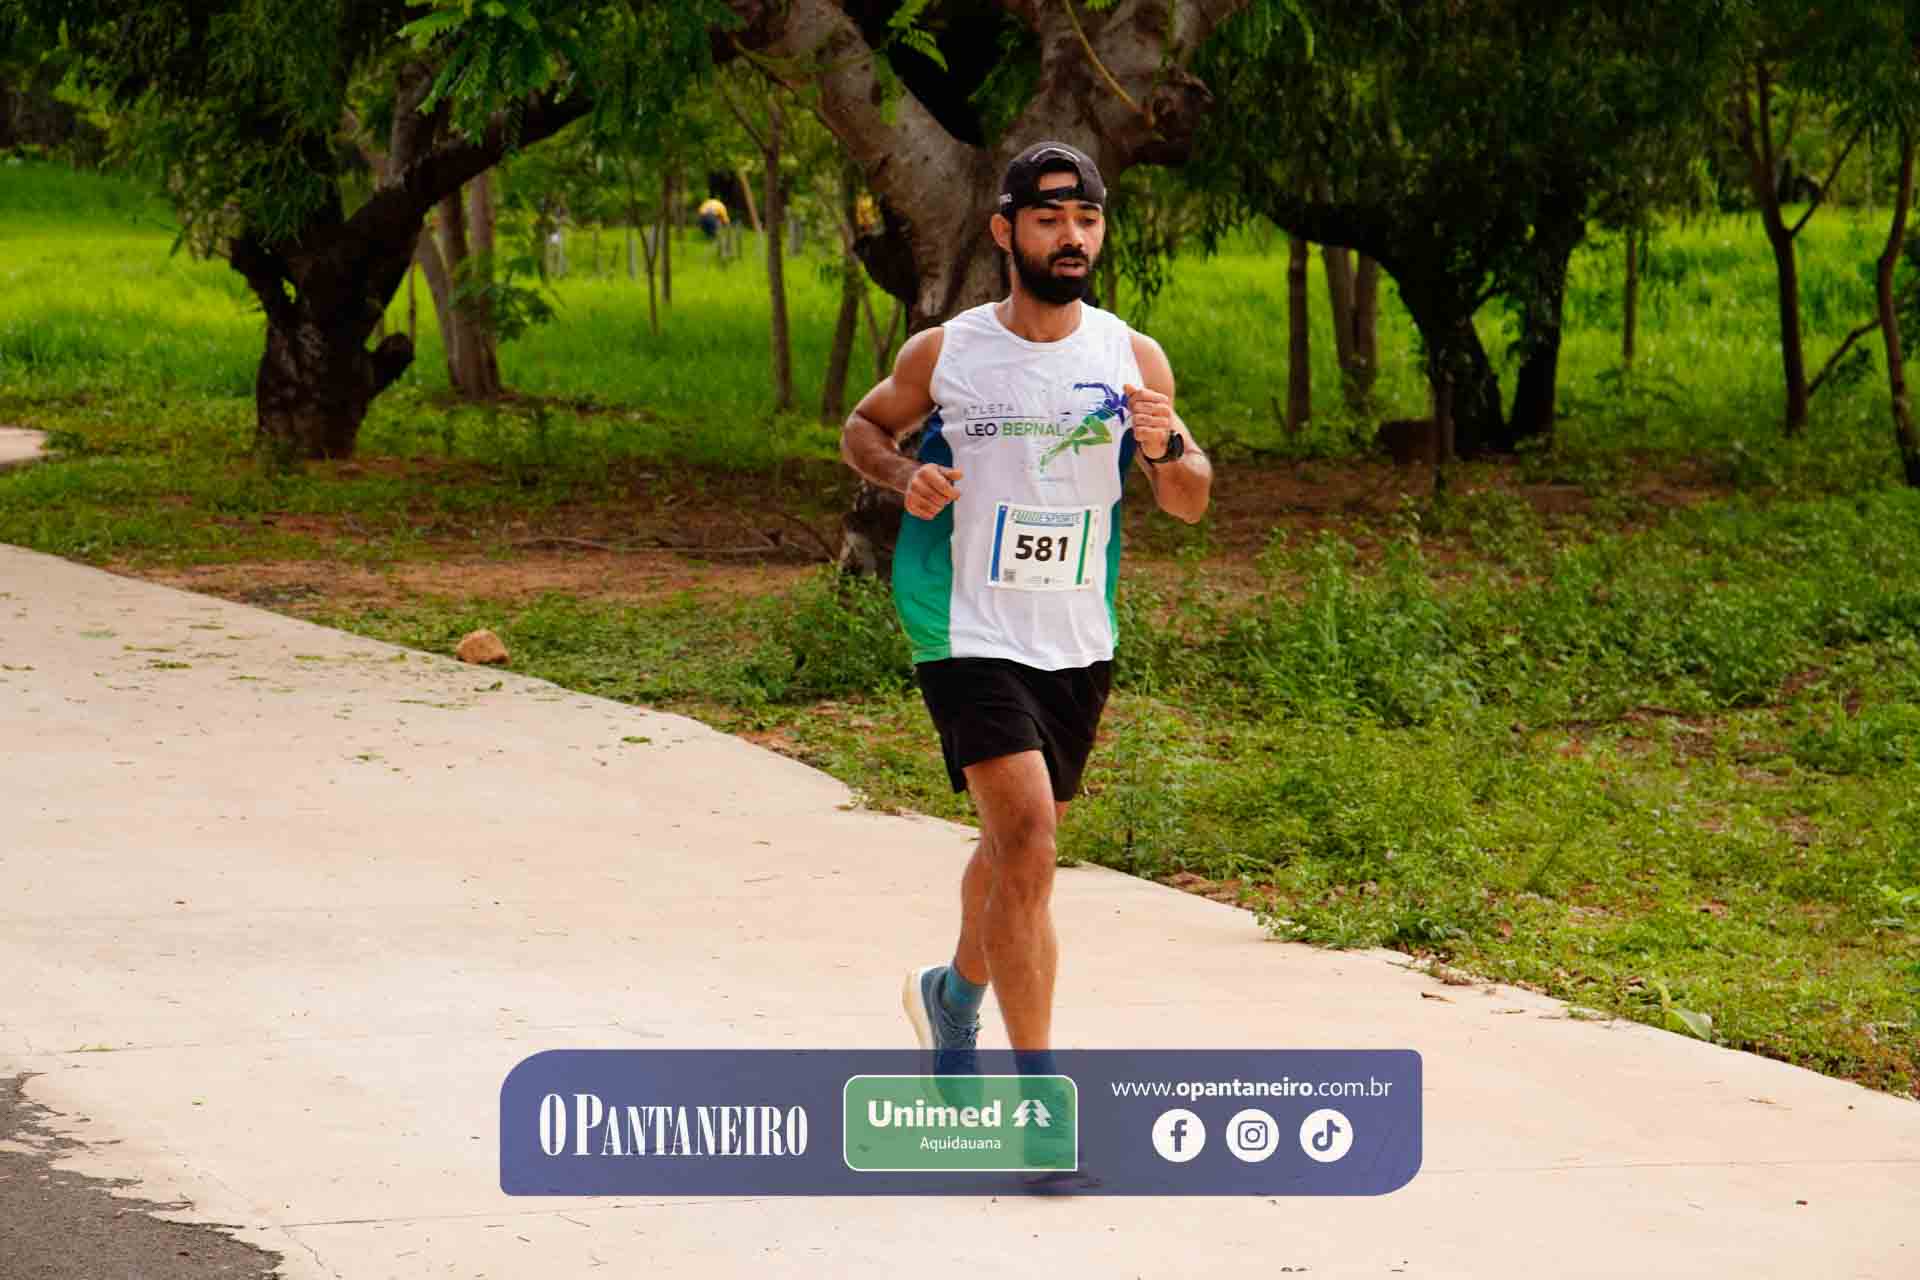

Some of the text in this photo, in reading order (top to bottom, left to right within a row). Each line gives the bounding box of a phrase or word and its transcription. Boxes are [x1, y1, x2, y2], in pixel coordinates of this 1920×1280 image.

[964, 421, 1065, 437] LEO BERNAL
[1015, 534, 1068, 561] 581
